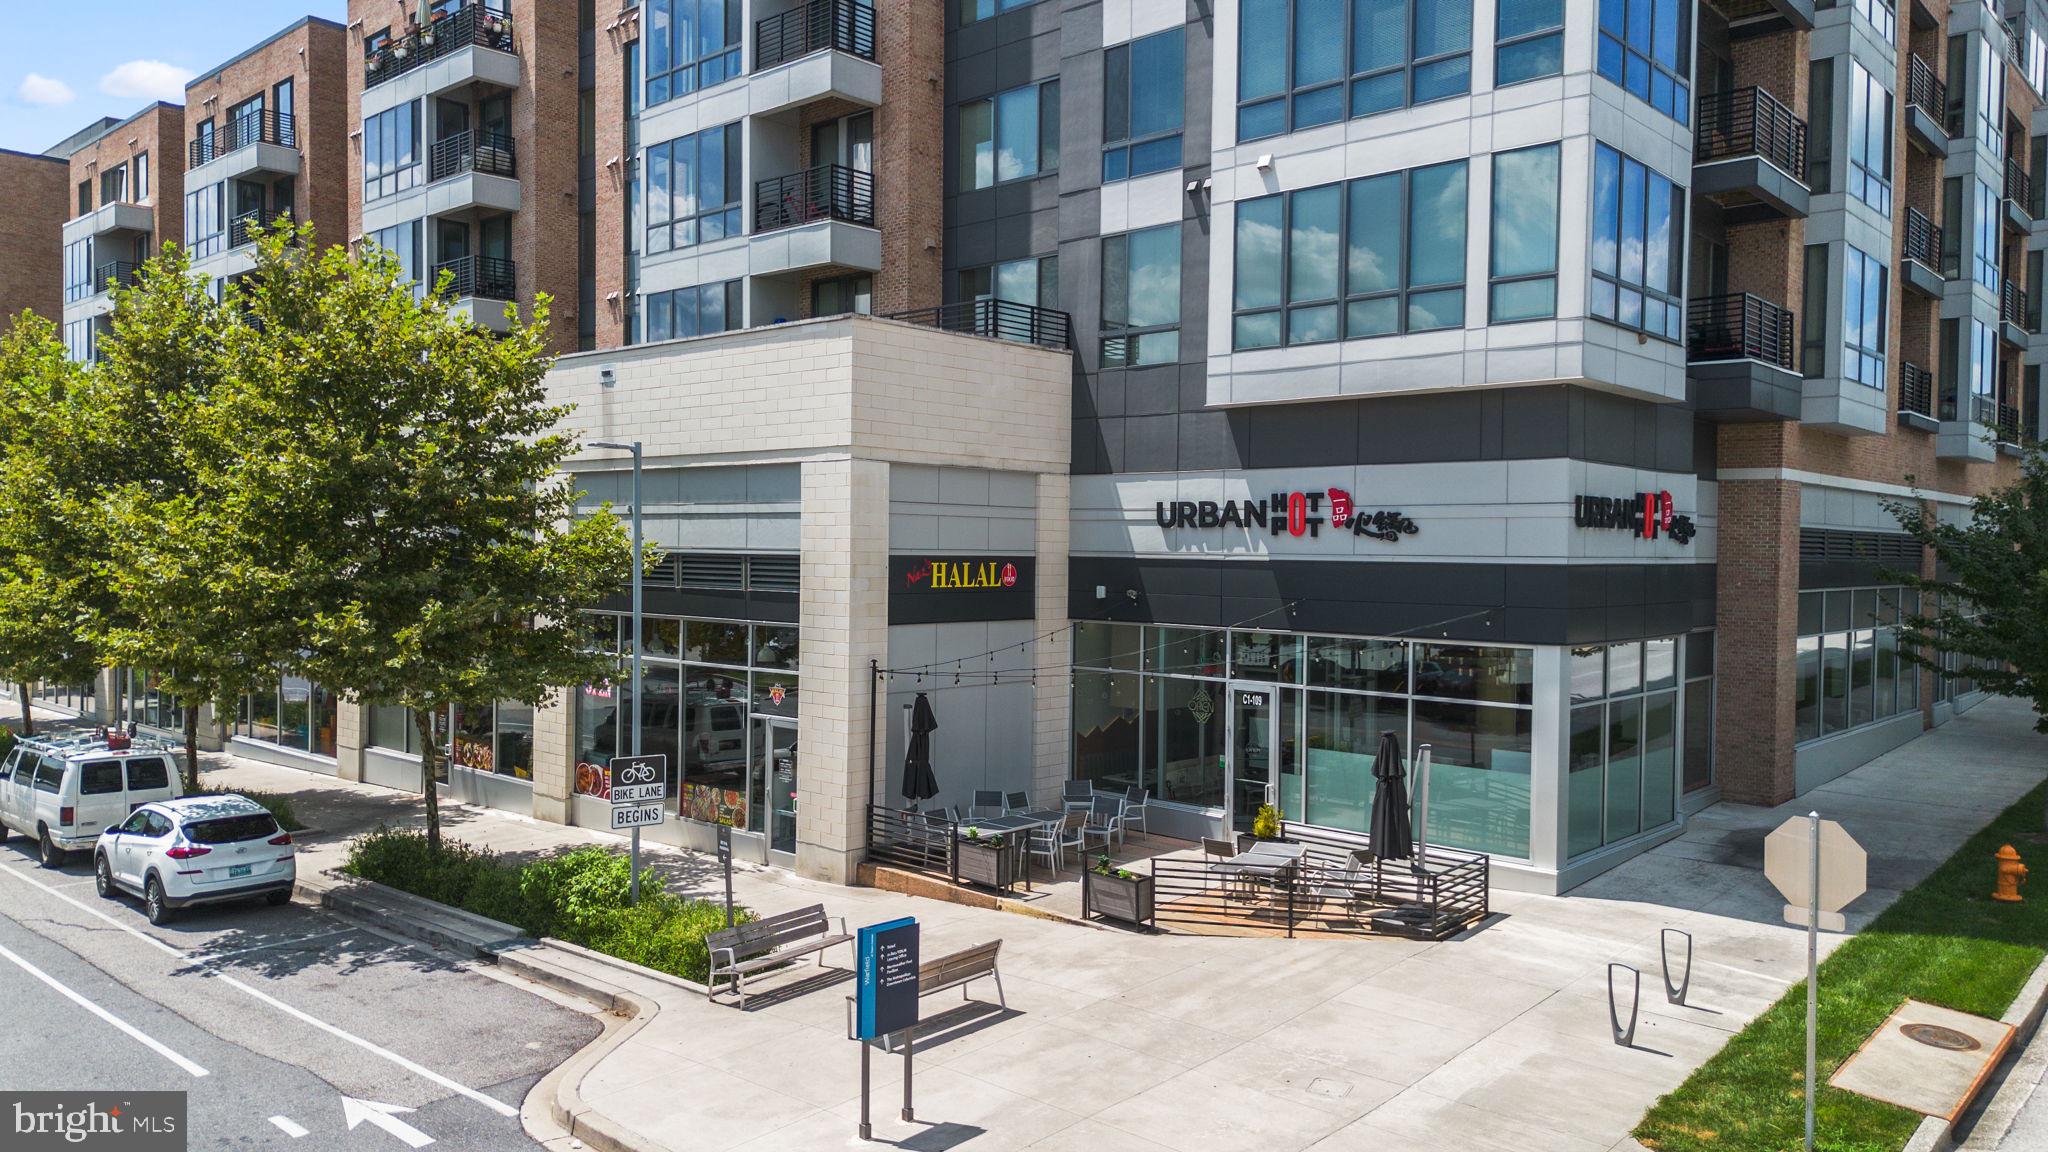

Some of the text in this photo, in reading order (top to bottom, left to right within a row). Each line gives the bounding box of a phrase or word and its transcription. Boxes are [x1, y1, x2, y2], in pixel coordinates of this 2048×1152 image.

[1156, 499, 1267, 528] URBAN
[1575, 494, 1636, 529] URBAN
[931, 562, 1002, 588] HALAL
[1242, 694, 1263, 706] C1-109
[614, 786, 662, 800] BIKE LANE
[618, 808, 659, 824] BEGINS
